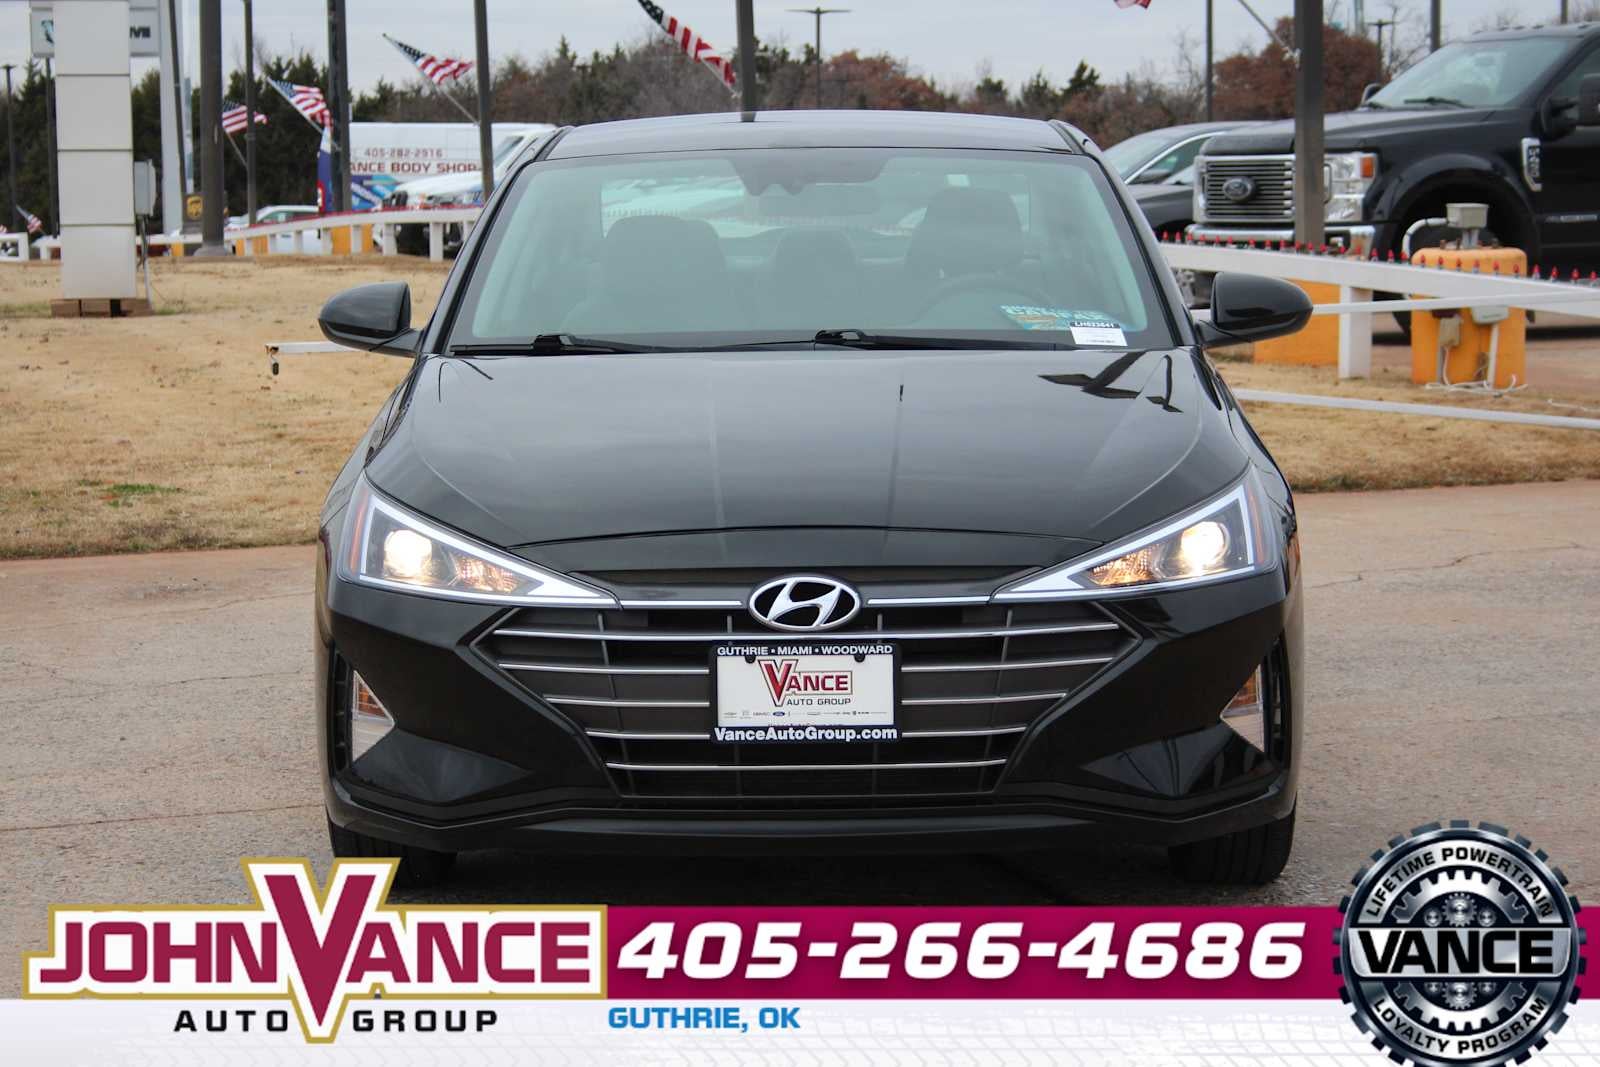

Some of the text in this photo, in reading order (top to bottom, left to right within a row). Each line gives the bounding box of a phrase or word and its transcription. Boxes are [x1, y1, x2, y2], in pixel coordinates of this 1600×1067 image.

[350, 162, 477, 173] ANCE BODY SHOP
[717, 645, 893, 656] GUTHRIE MIAMI WOODWARD
[763, 661, 849, 704] VANCE
[786, 698, 851, 706] AUTO GROUP
[714, 727, 897, 742] VanceAutoGroup.com
